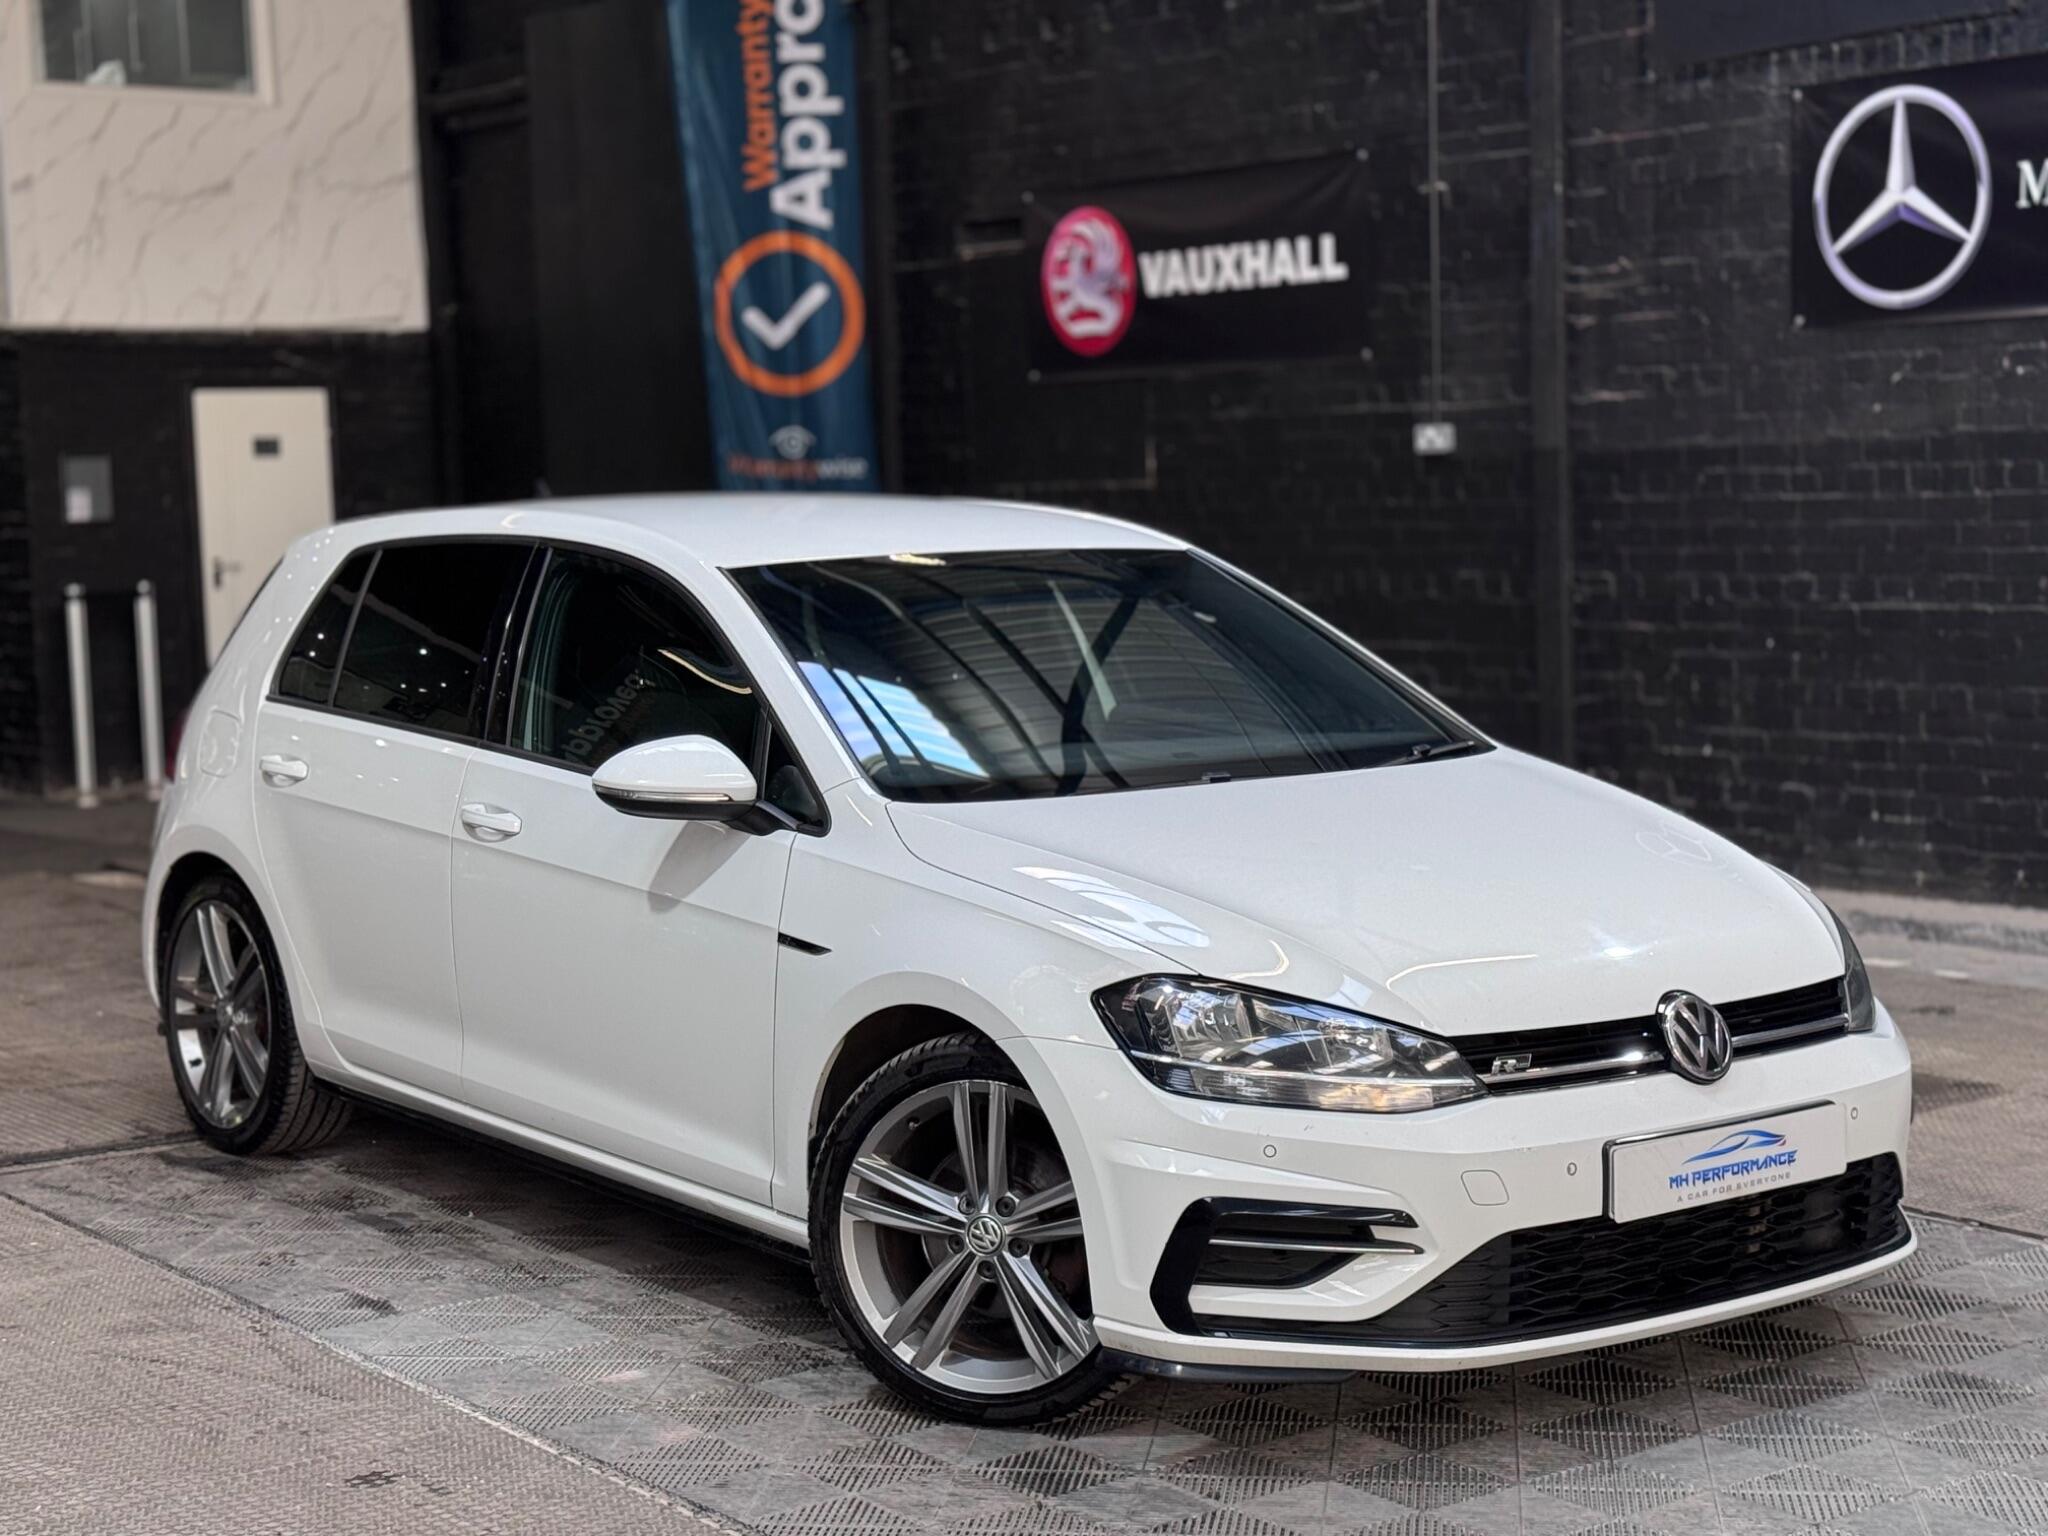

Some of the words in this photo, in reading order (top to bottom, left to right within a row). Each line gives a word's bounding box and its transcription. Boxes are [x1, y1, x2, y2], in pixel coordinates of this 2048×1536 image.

[1137, 232, 1349, 299] VAUXHALL
[1668, 1172, 1689, 1189] MH
[1691, 1150, 1797, 1187] PERFORMANCE
[1687, 1190, 1709, 1201] CAR
[1712, 1184, 1733, 1195] FOR
[1736, 1172, 1791, 1190] EVERYONE
